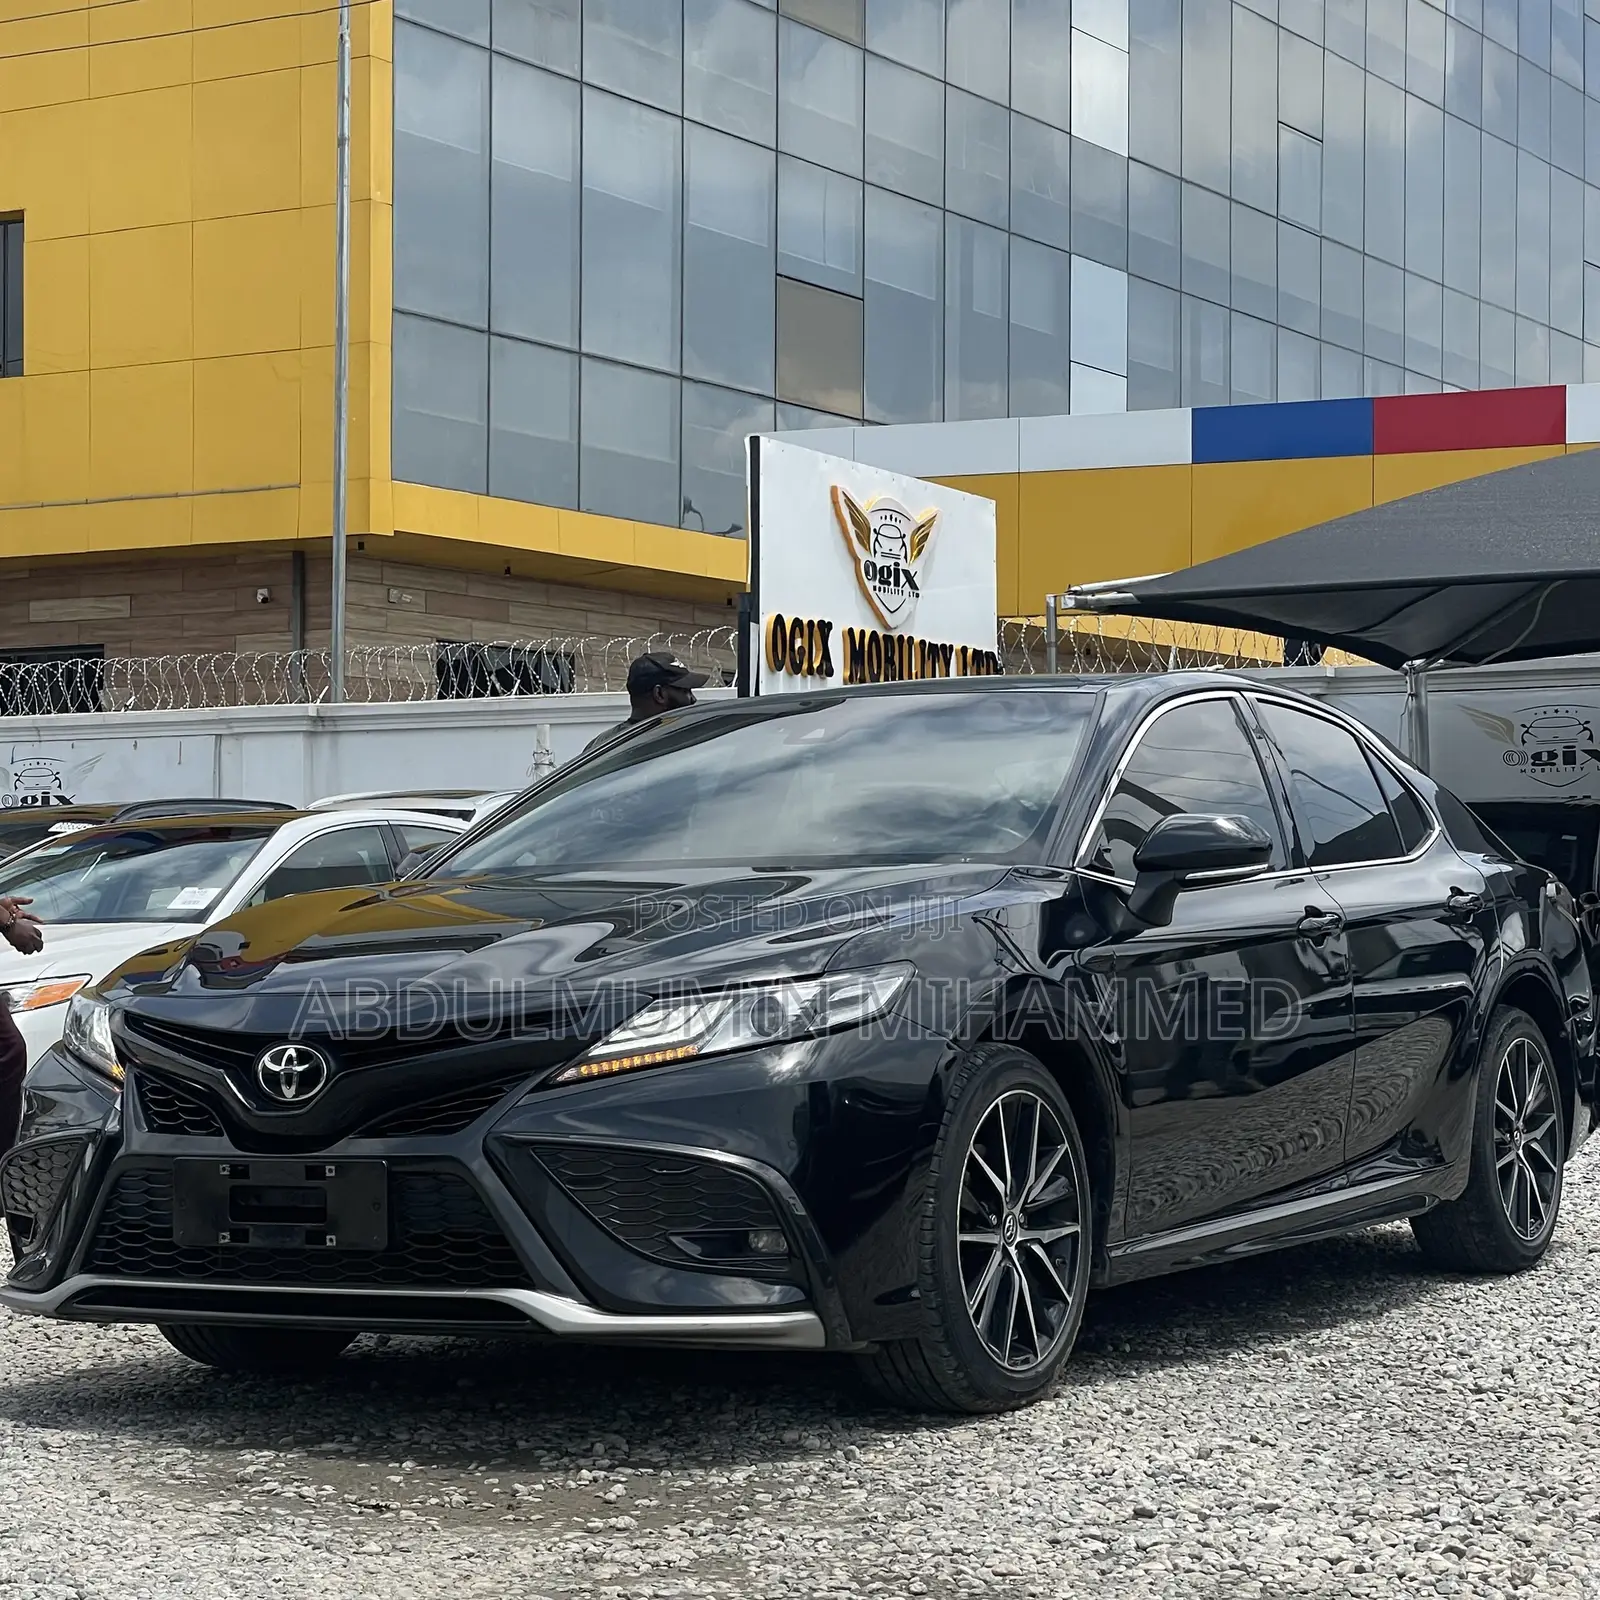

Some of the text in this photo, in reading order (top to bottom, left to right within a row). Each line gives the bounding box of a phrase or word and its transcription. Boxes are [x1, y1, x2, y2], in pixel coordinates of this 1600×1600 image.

[765, 613, 834, 678] OGIX
[842, 626, 954, 685] MOBILITY
[1520, 766, 1584, 774] MOBILITY
